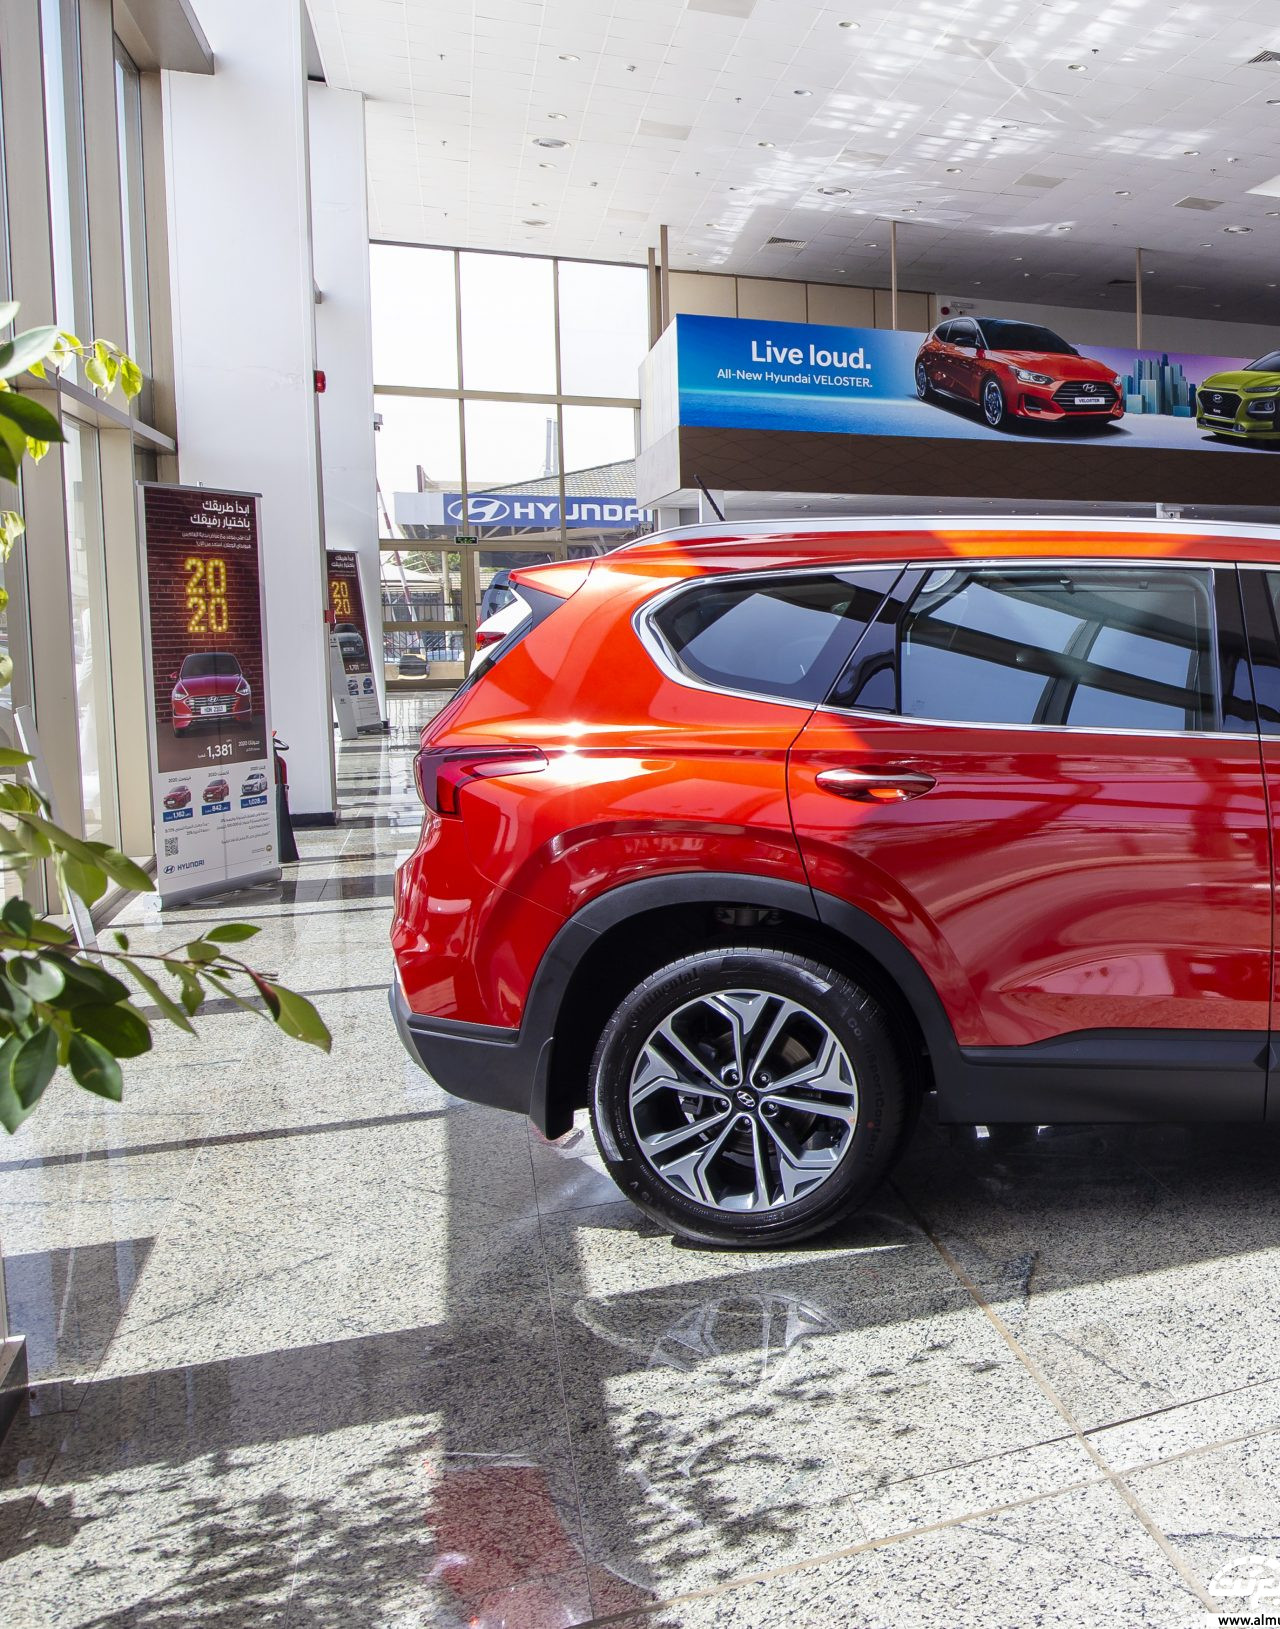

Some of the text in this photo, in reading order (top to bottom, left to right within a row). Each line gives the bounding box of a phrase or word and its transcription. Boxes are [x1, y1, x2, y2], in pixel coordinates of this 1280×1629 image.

[751, 340, 871, 369] Live loud.
[717, 368, 873, 388] All-New Hyundai VELOSTER.
[202, 500, 250, 516] ابدأ طريقك
[514, 502, 653, 521] HYUNDAI
[190, 513, 251, 531] باختيار رفيقك
[184, 557, 227, 595] 20
[331, 581, 349, 598] 20
[186, 596, 229, 633] 20
[334, 598, 351, 615] 20
[206, 743, 233, 759] 1,381
[177, 859, 205, 871] HYUNDAI
